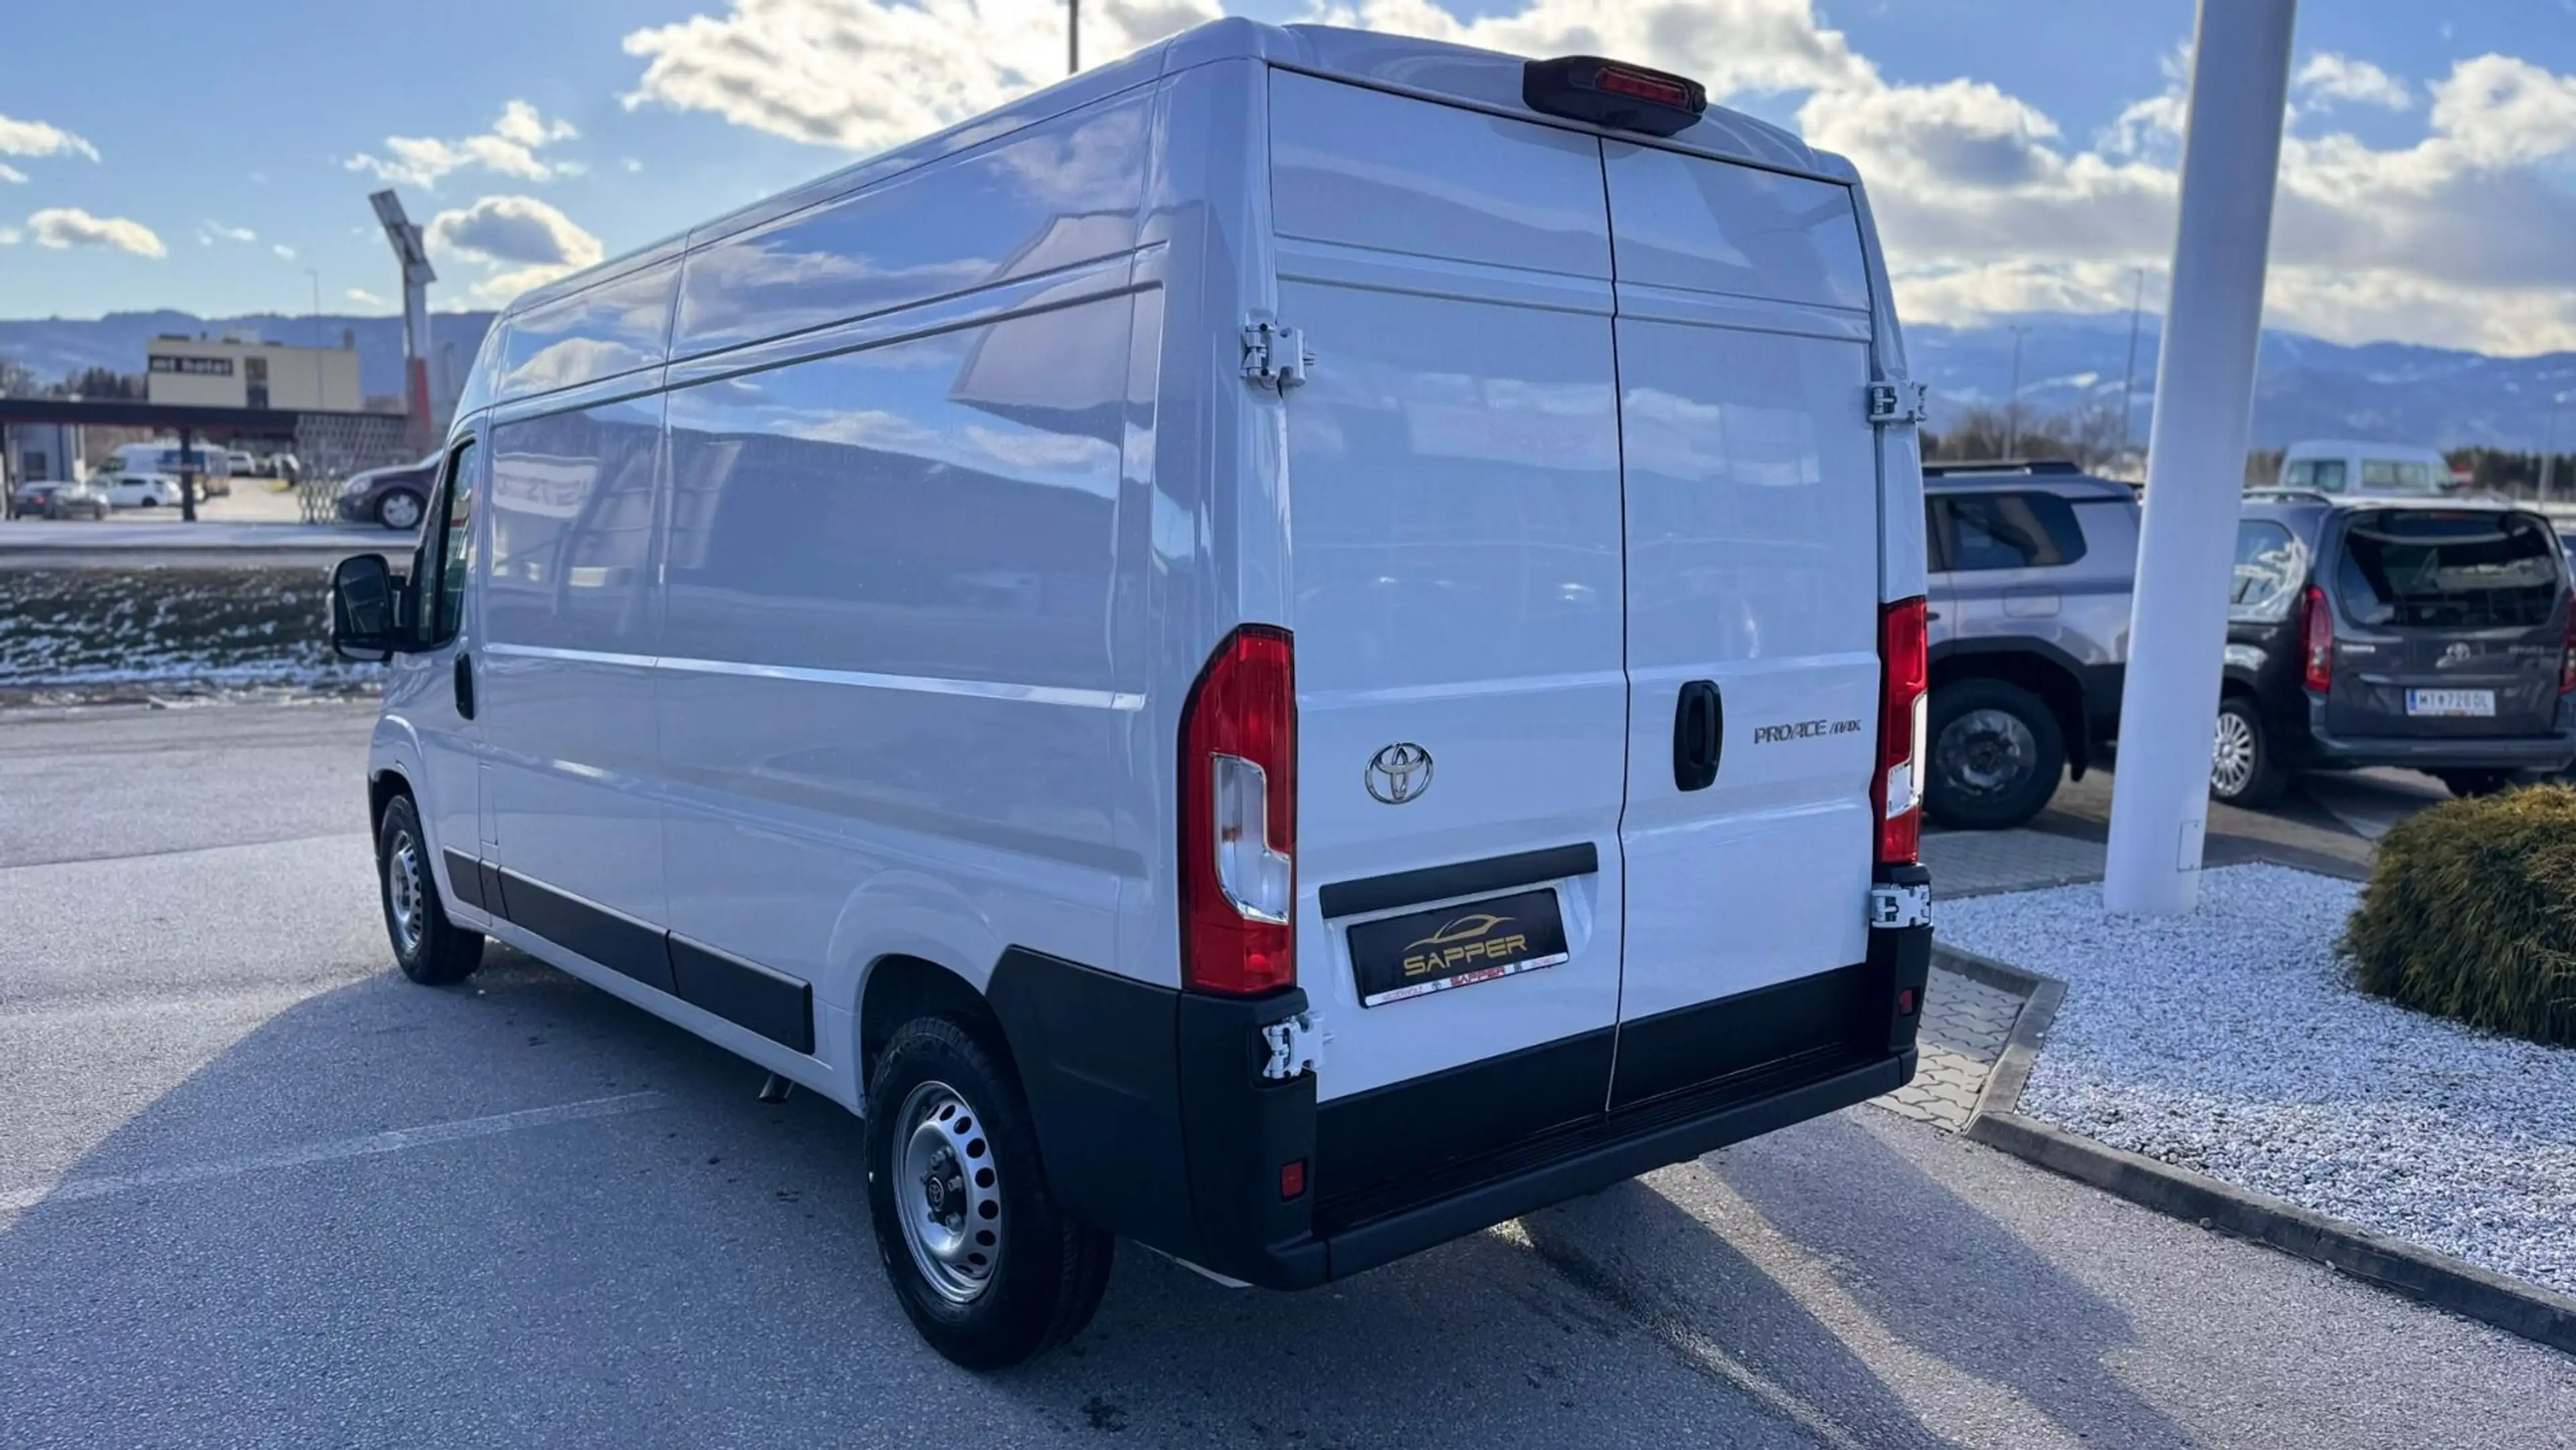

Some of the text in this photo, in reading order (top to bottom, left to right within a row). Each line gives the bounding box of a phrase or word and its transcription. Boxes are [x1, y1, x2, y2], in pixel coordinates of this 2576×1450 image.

[181, 357, 229, 374] hotel
[1754, 719, 1828, 745] PROACE
[1403, 934, 1527, 976] SAPPER
[1450, 966, 1505, 986] SAPPER
